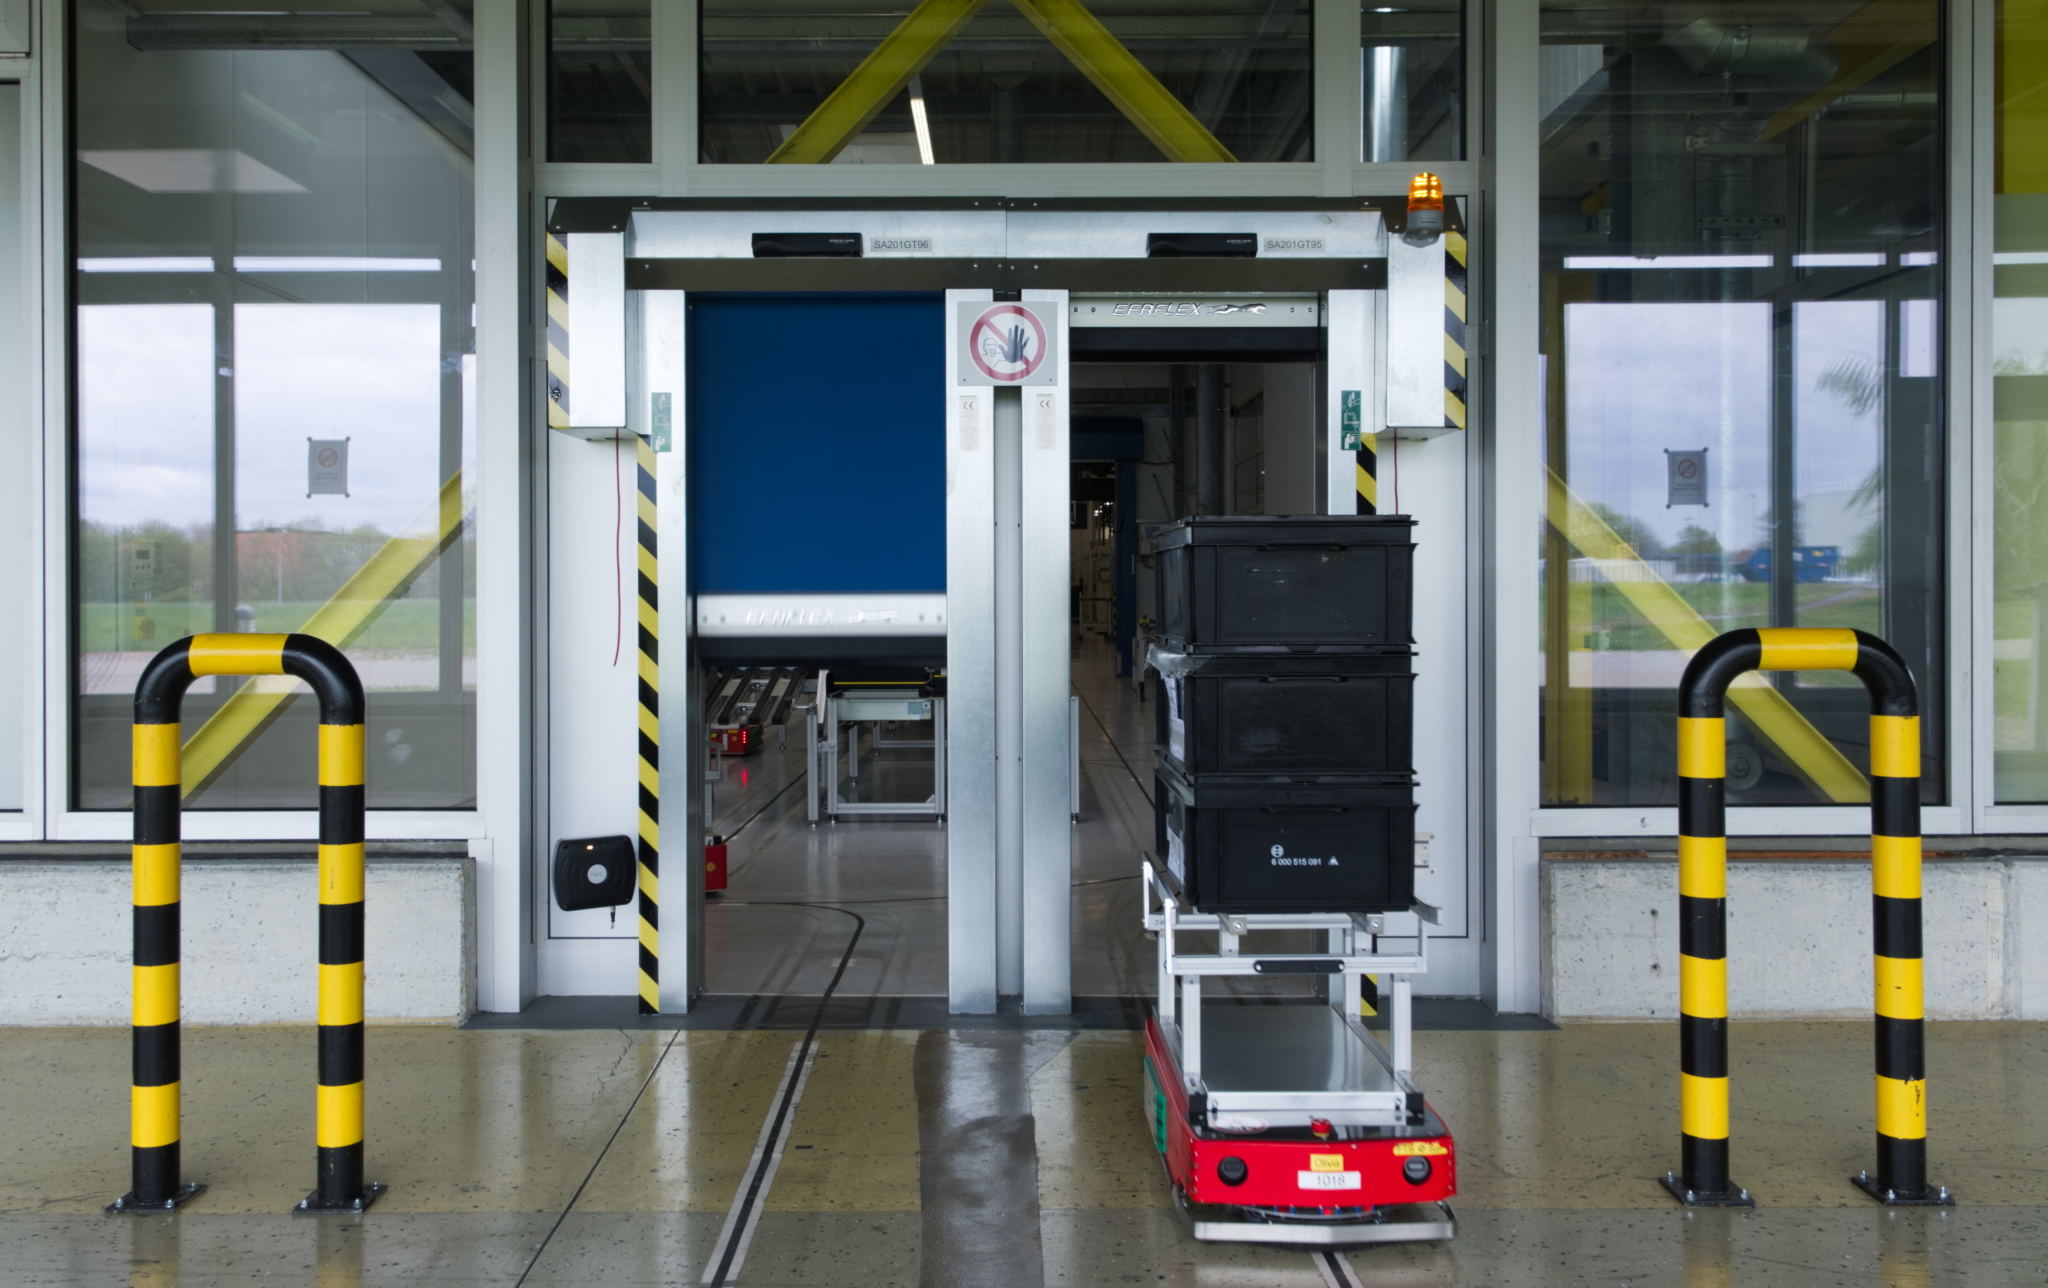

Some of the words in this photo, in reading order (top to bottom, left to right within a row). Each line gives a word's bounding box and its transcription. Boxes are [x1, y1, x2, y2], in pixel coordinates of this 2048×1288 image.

[874, 240, 929, 249] SA201GT96
[1267, 240, 1322, 249] SA201GT95
[1112, 303, 1204, 316] EFAFLEX
[1271, 858, 1277, 866] 6
[1278, 858, 1292, 866] 000
[1293, 858, 1307, 866] 515
[1308, 858, 1321, 866] 091
[1316, 1174, 1346, 1188] 1018
